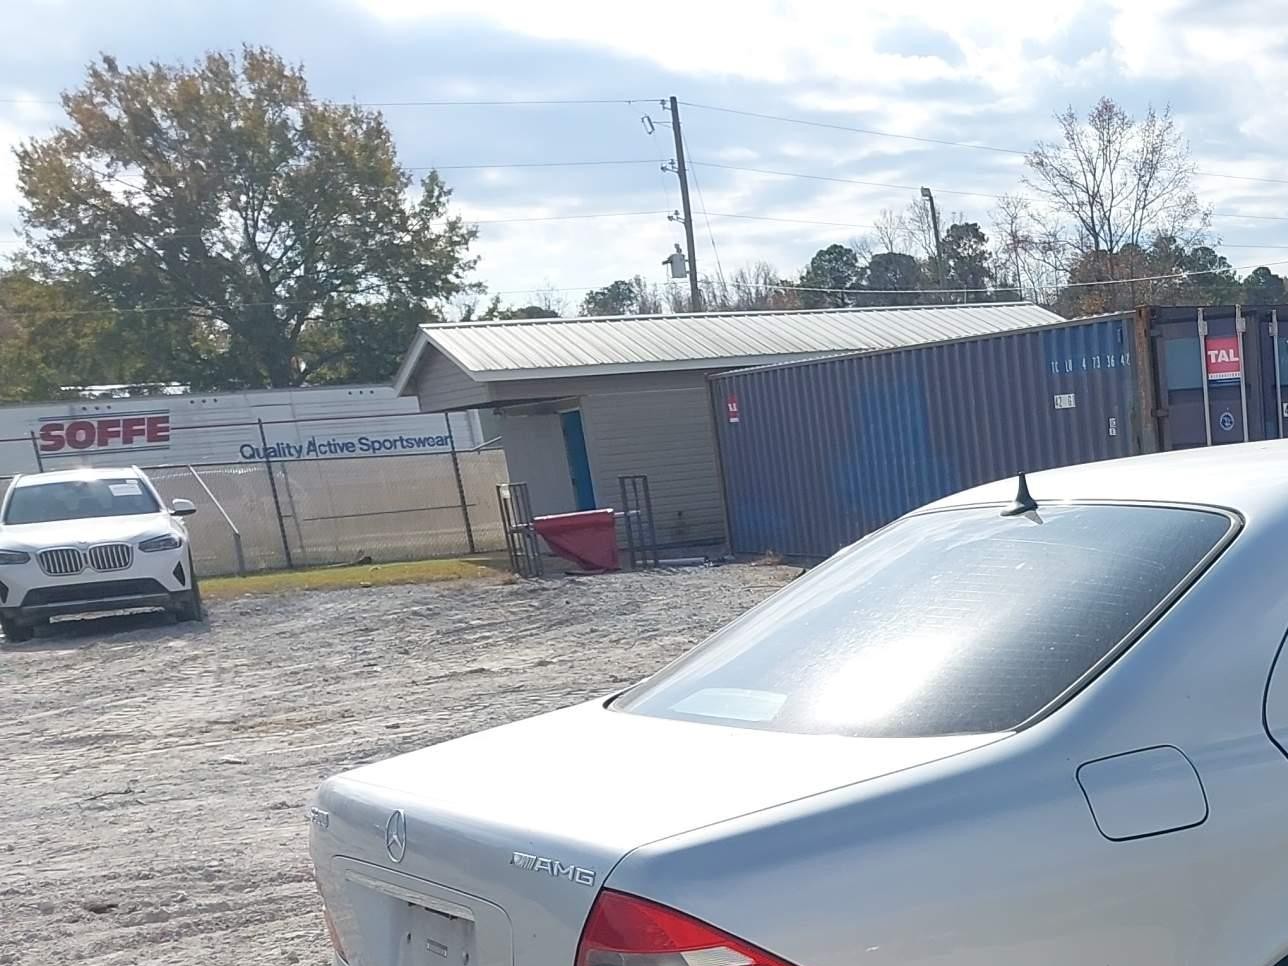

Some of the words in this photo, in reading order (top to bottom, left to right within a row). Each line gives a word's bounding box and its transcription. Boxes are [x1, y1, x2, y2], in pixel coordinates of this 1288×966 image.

[1207, 349, 1240, 363] TAL
[40, 415, 170, 452] SOFFE
[239, 443, 303, 460] Quality
[306, 437, 356, 456] Active
[357, 434, 452, 454] Sportswear
[534, 857, 596, 886] AMG
